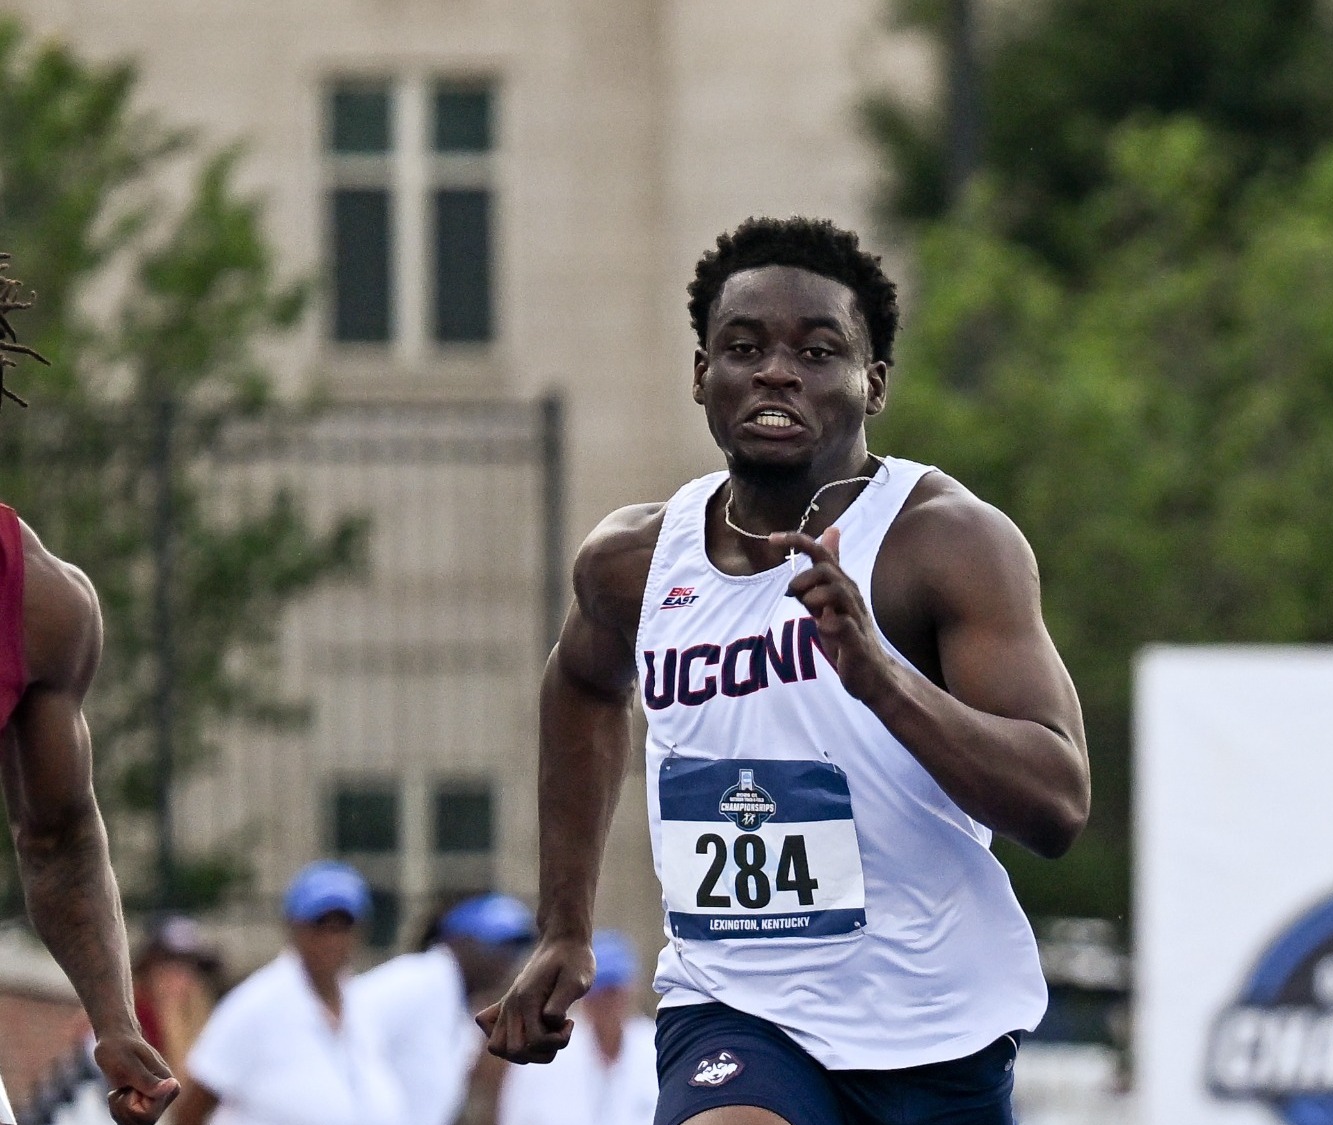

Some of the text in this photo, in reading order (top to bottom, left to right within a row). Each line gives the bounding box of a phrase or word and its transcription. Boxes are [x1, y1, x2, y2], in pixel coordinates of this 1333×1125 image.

[668, 587, 695, 597] BIG
[661, 595, 700, 606] EAST
[695, 833, 819, 909] 284
[710, 916, 811, 931] LEXINGTON, KENTUCKY
